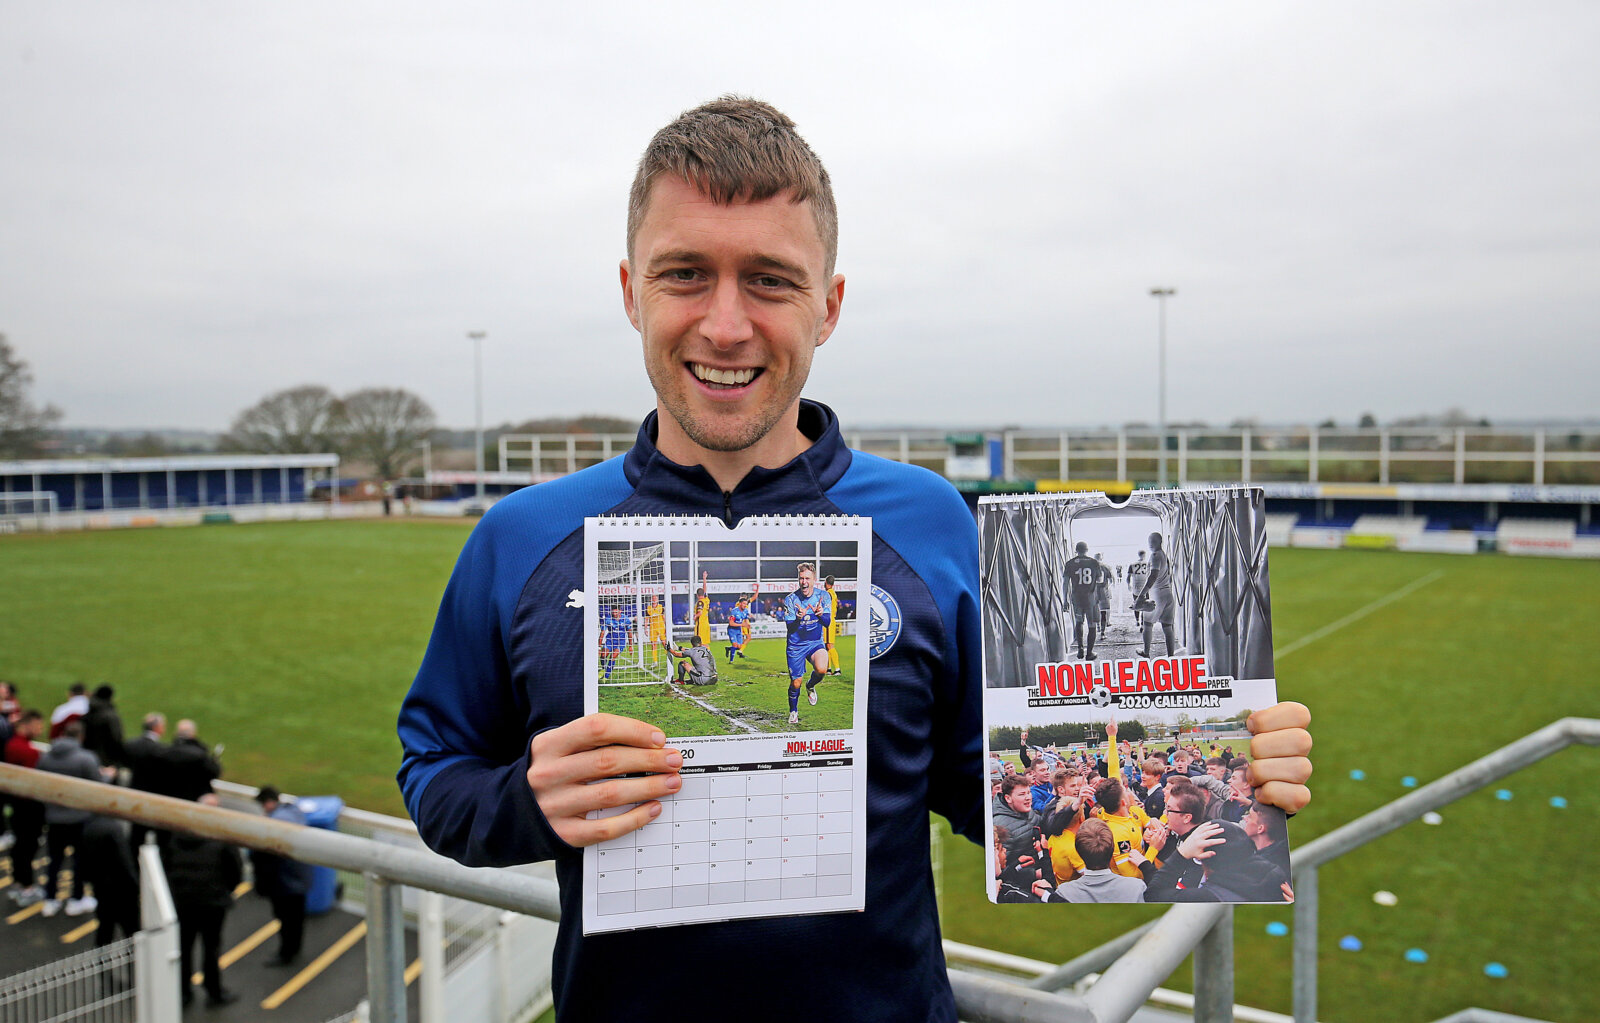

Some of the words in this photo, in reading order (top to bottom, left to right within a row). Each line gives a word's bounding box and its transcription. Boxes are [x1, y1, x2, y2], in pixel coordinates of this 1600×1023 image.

[1134, 563, 1147, 575] 23
[1075, 567, 1092, 585] 18
[1027, 688, 1039, 697] THE
[1038, 657, 1207, 697] NON-LEAGUE
[1207, 679, 1229, 689] PAPER
[1119, 695, 1151, 708] 2020
[1154, 695, 1220, 708] CALENDAR
[786, 739, 845, 753] NON-LEAGUE
[680, 748, 695, 759] 20
